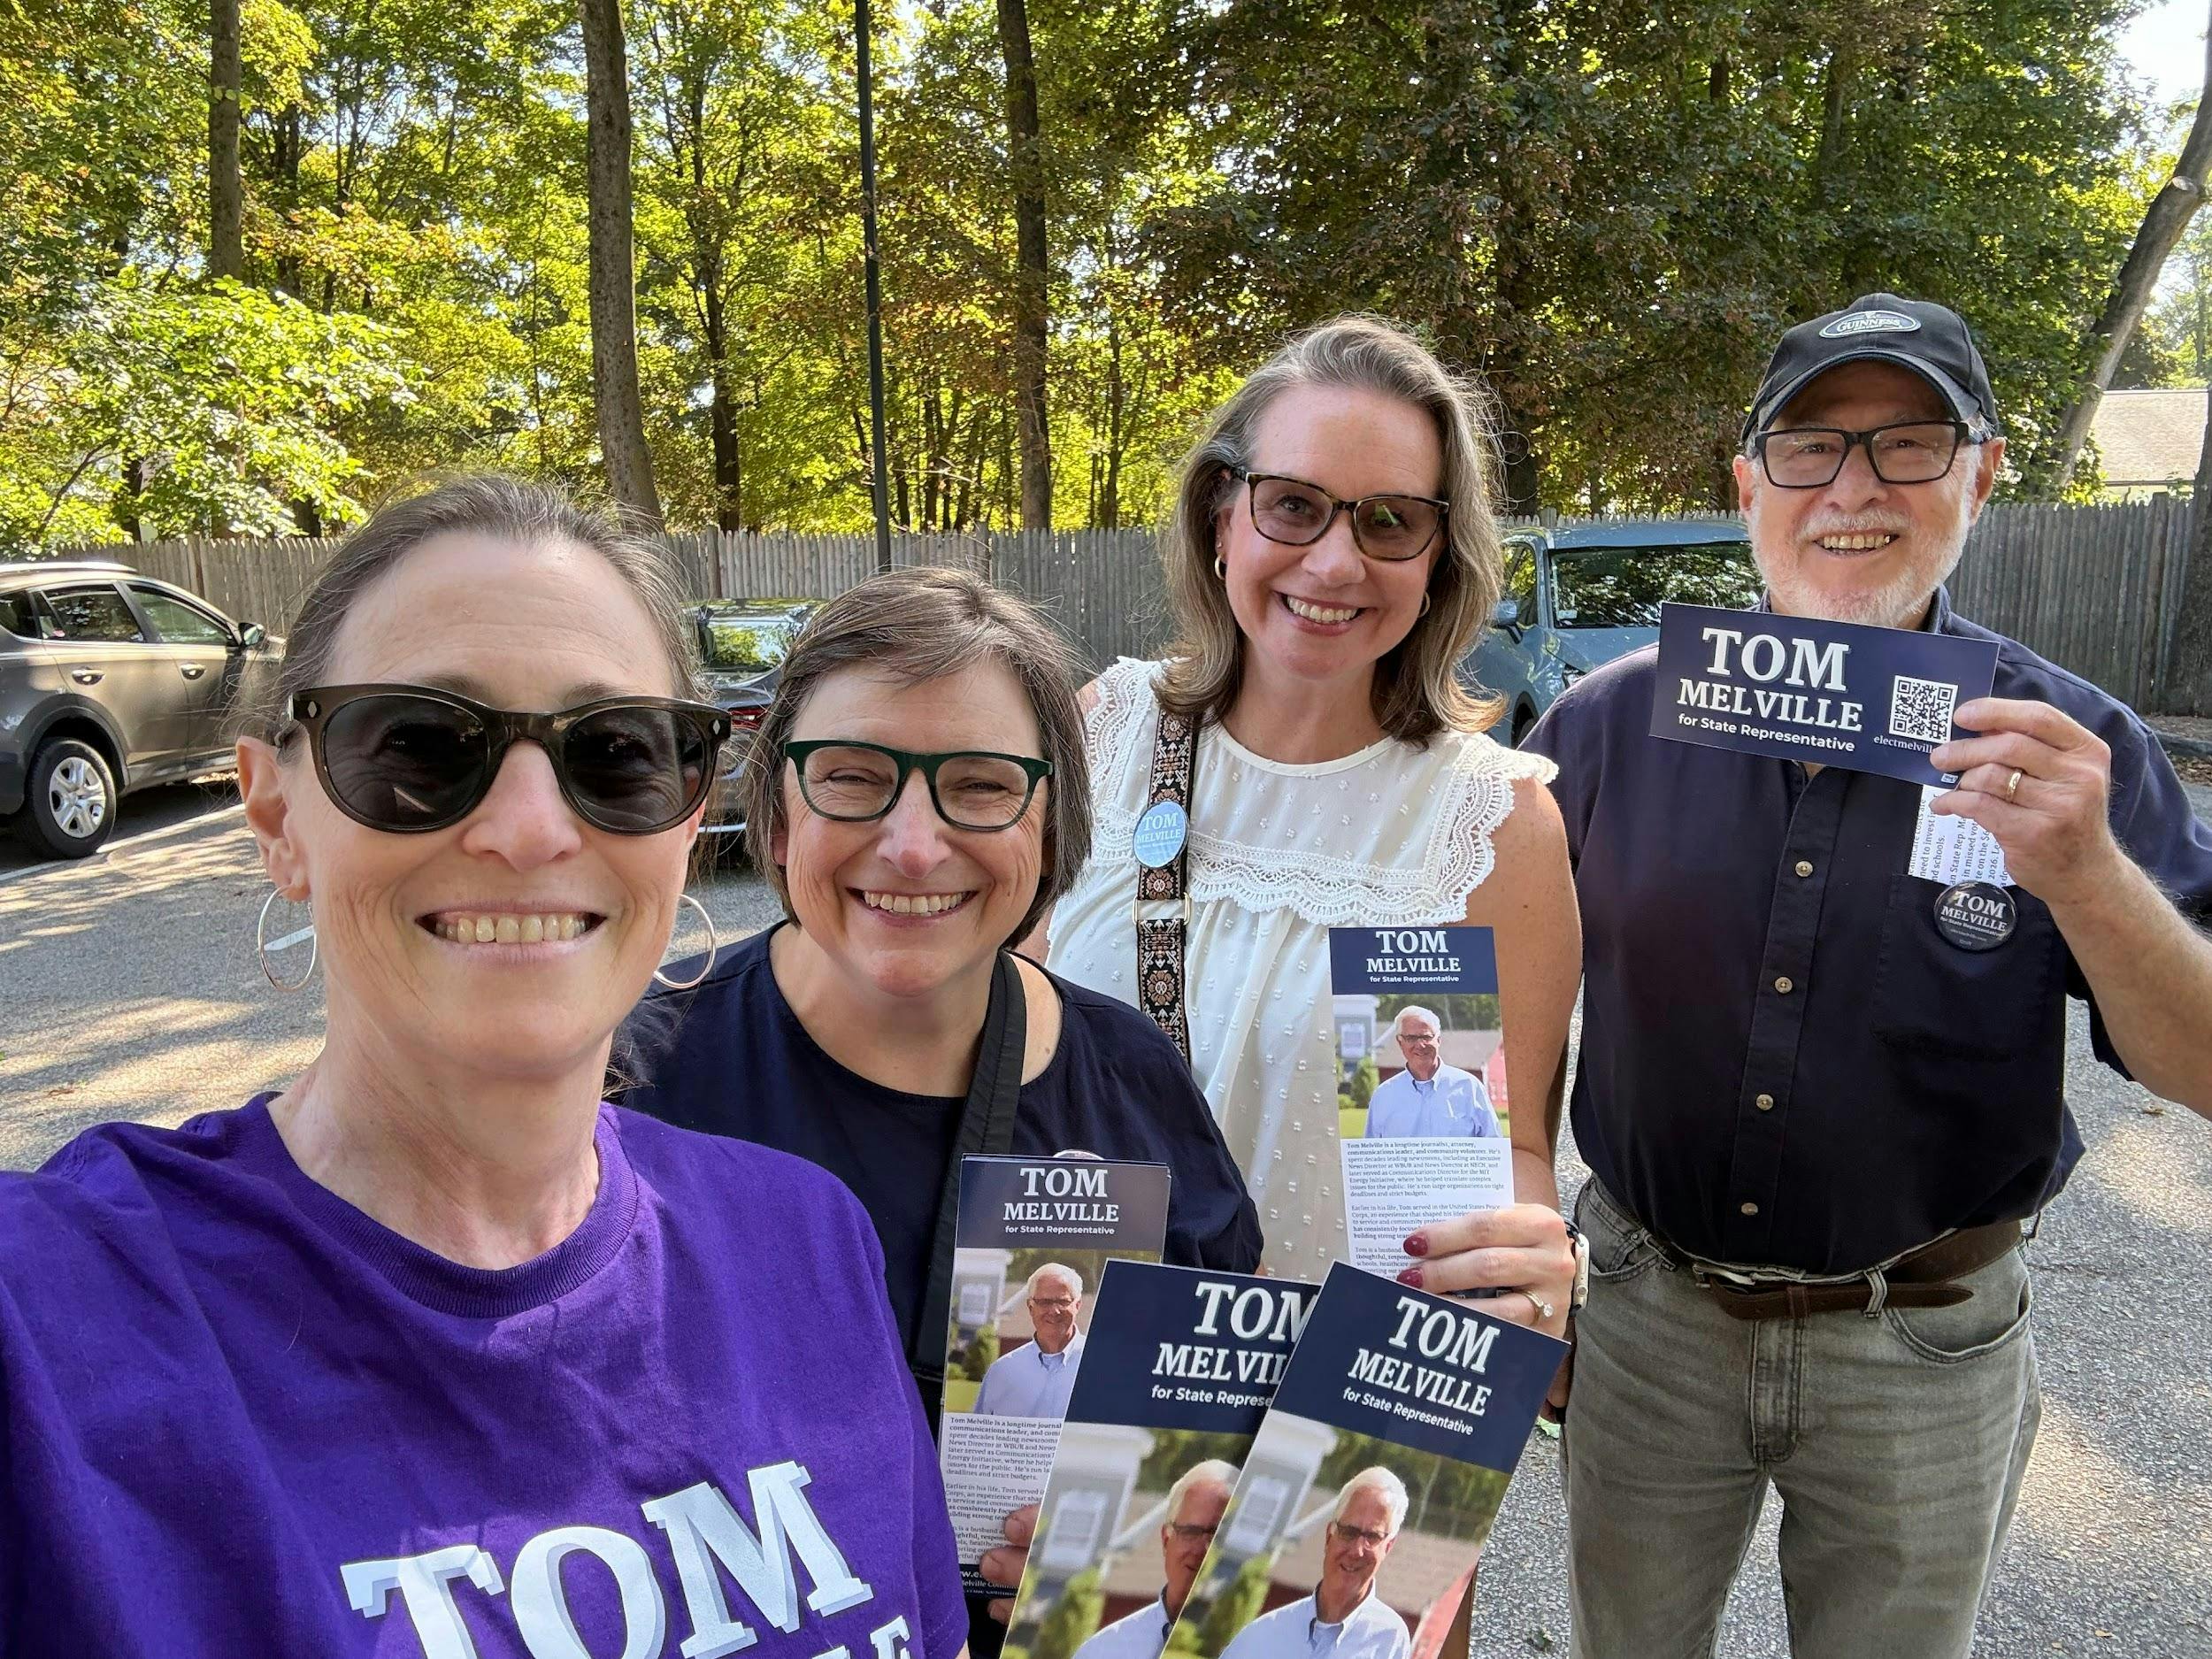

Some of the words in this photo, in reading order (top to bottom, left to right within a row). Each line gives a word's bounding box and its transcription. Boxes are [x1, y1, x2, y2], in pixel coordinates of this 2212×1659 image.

[1837, 319, 1901, 332] GUINNESS
[1701, 627, 1851, 692] TOM
[1677, 678, 1863, 732] MELVILLE
[1678, 713, 1698, 726] for
[1701, 717, 1737, 733] State
[1740, 724, 1855, 752] Representative
[1874, 734, 1933, 754] electmelvill
[1142, 813, 1179, 832] TOM
[1924, 818, 1935, 845] invest
[1137, 828, 1181, 843] MELVILLE
[1954, 833, 1966, 850] Rep.
[1923, 846, 1931, 856] to
[1934, 835, 1946, 869] schools.
[1950, 850, 1961, 872] State
[1965, 837, 1977, 869] missed
[1978, 842, 1988, 858] the
[1920, 856, 1929, 877] need
[1978, 858, 1985, 869] on
[1988, 856, 1999, 879] 2026.
[1952, 890, 2006, 918] TOM
[1940, 905, 2008, 932] MELVILLE
[1375, 930, 1449, 954] TOM
[1366, 957, 1461, 972] MELVILLE
[1403, 975, 1460, 984] Representative
[1019, 1167, 1108, 1198] TOM
[1002, 1202, 1119, 1222] MELVILLE
[1005, 1225, 1018, 1233] for
[1019, 1225, 1044, 1233] State
[1046, 1225, 1115, 1235] Representative
[1193, 1281, 1319, 1343] TOM
[1388, 1295, 1502, 1374] TOM
[1151, 1342, 1288, 1385] MELVIL
[1348, 1348, 1493, 1417] MELVILLE
[1151, 1384, 1173, 1400] for
[1176, 1386, 1214, 1403] State
[1217, 1390, 1273, 1409] Represe
[1342, 1386, 1360, 1402] for
[1361, 1392, 1393, 1412] State
[1393, 1402, 1474, 1436] Representative
[995, 1450, 1051, 1459] Communications
[340, 1460, 874, 1659] TOM
